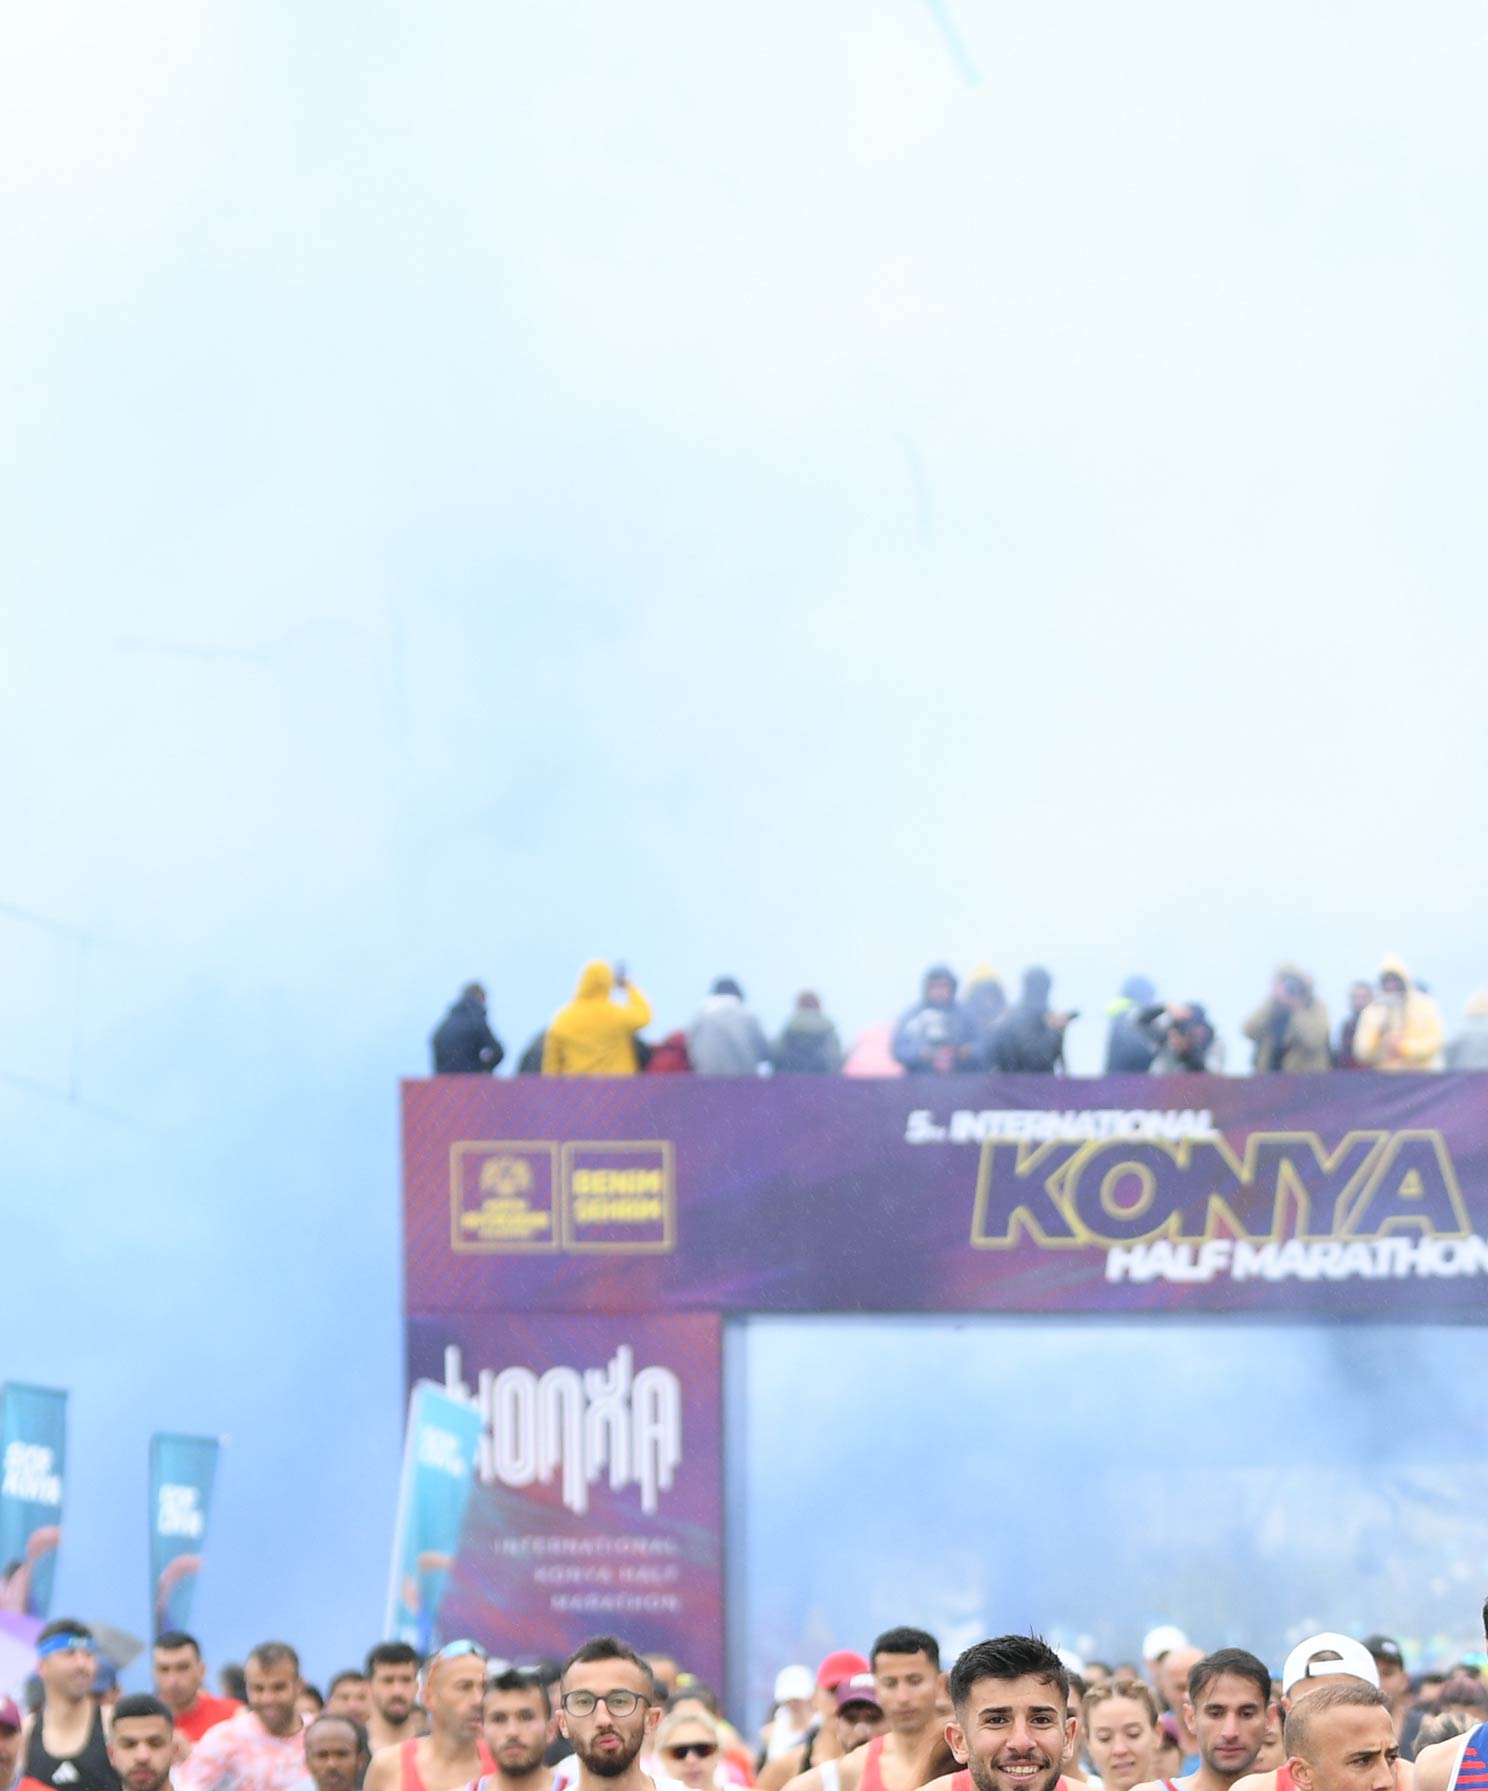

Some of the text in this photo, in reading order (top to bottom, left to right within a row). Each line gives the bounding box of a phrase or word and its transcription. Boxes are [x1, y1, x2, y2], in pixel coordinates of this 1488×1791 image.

[950, 1109, 1219, 1141] INTERNATIONAL
[970, 1129, 1472, 1248] KONYA
[1106, 1240, 1228, 1282] HALF
